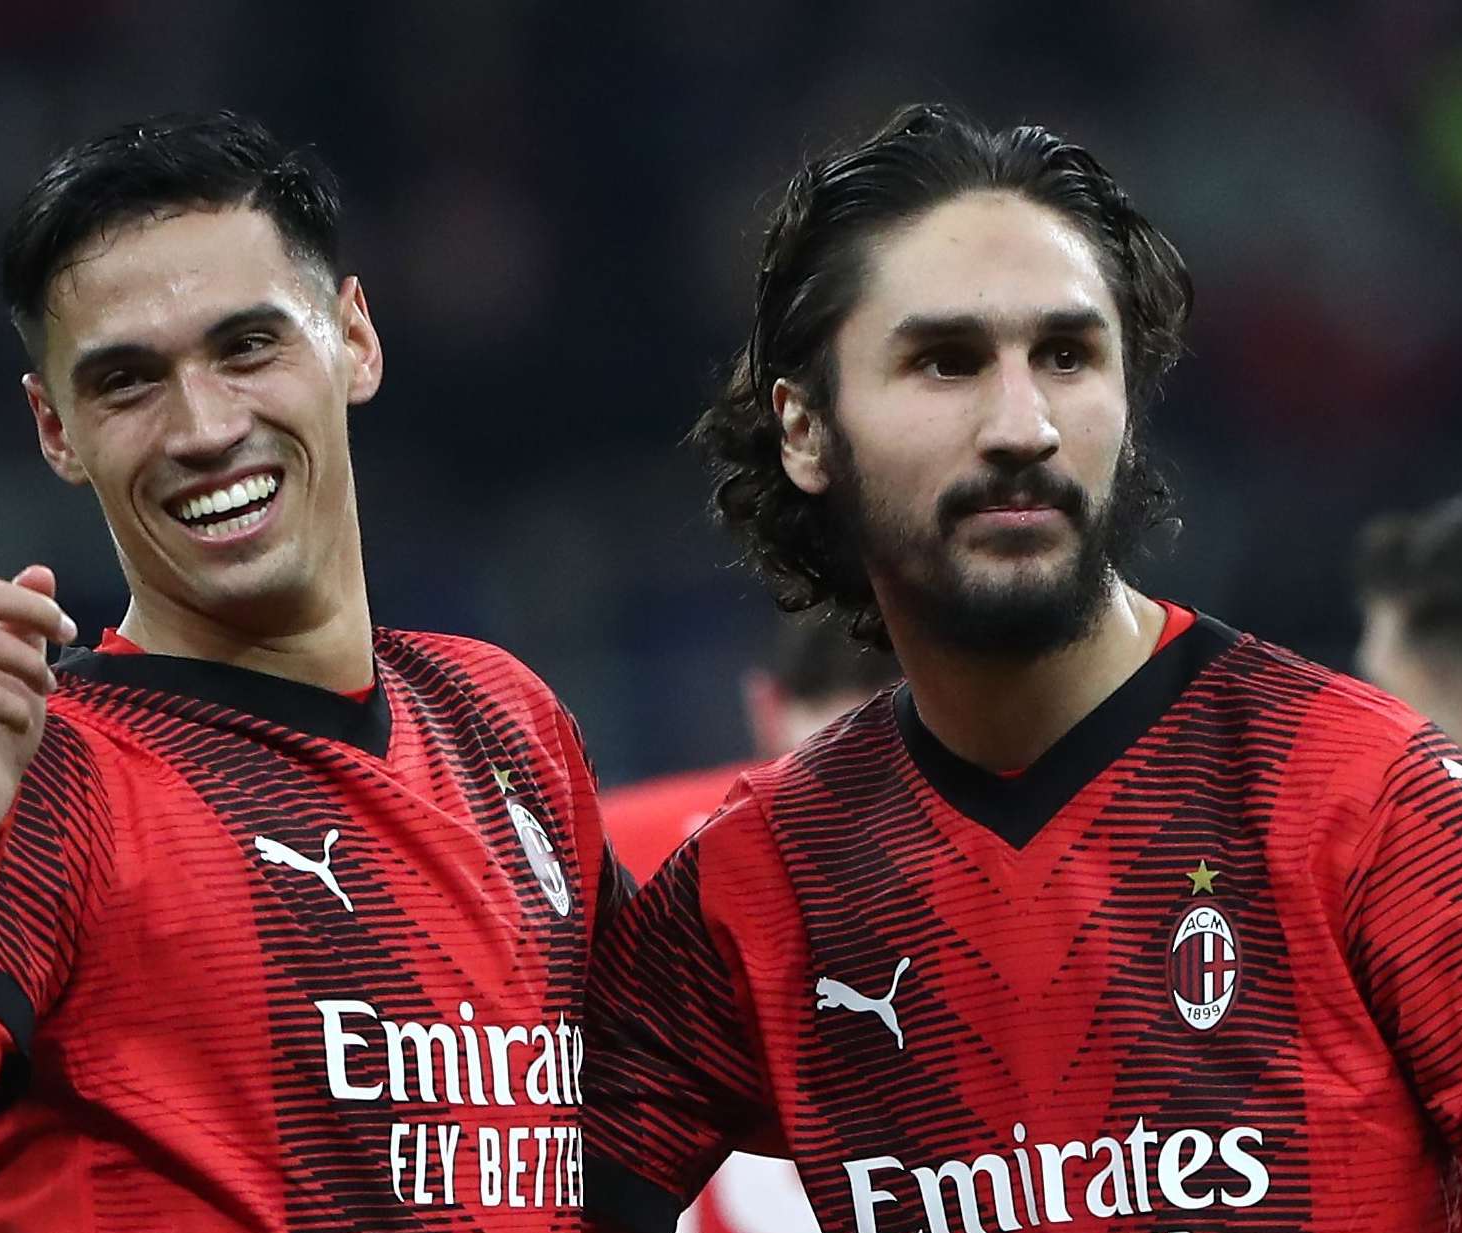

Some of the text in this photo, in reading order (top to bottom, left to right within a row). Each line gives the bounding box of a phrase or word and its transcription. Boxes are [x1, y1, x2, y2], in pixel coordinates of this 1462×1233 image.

[1182, 911, 1225, 937] ACM
[1187, 1004, 1221, 1020] 1899
[389, 1122, 584, 1208] FLY BETTE
